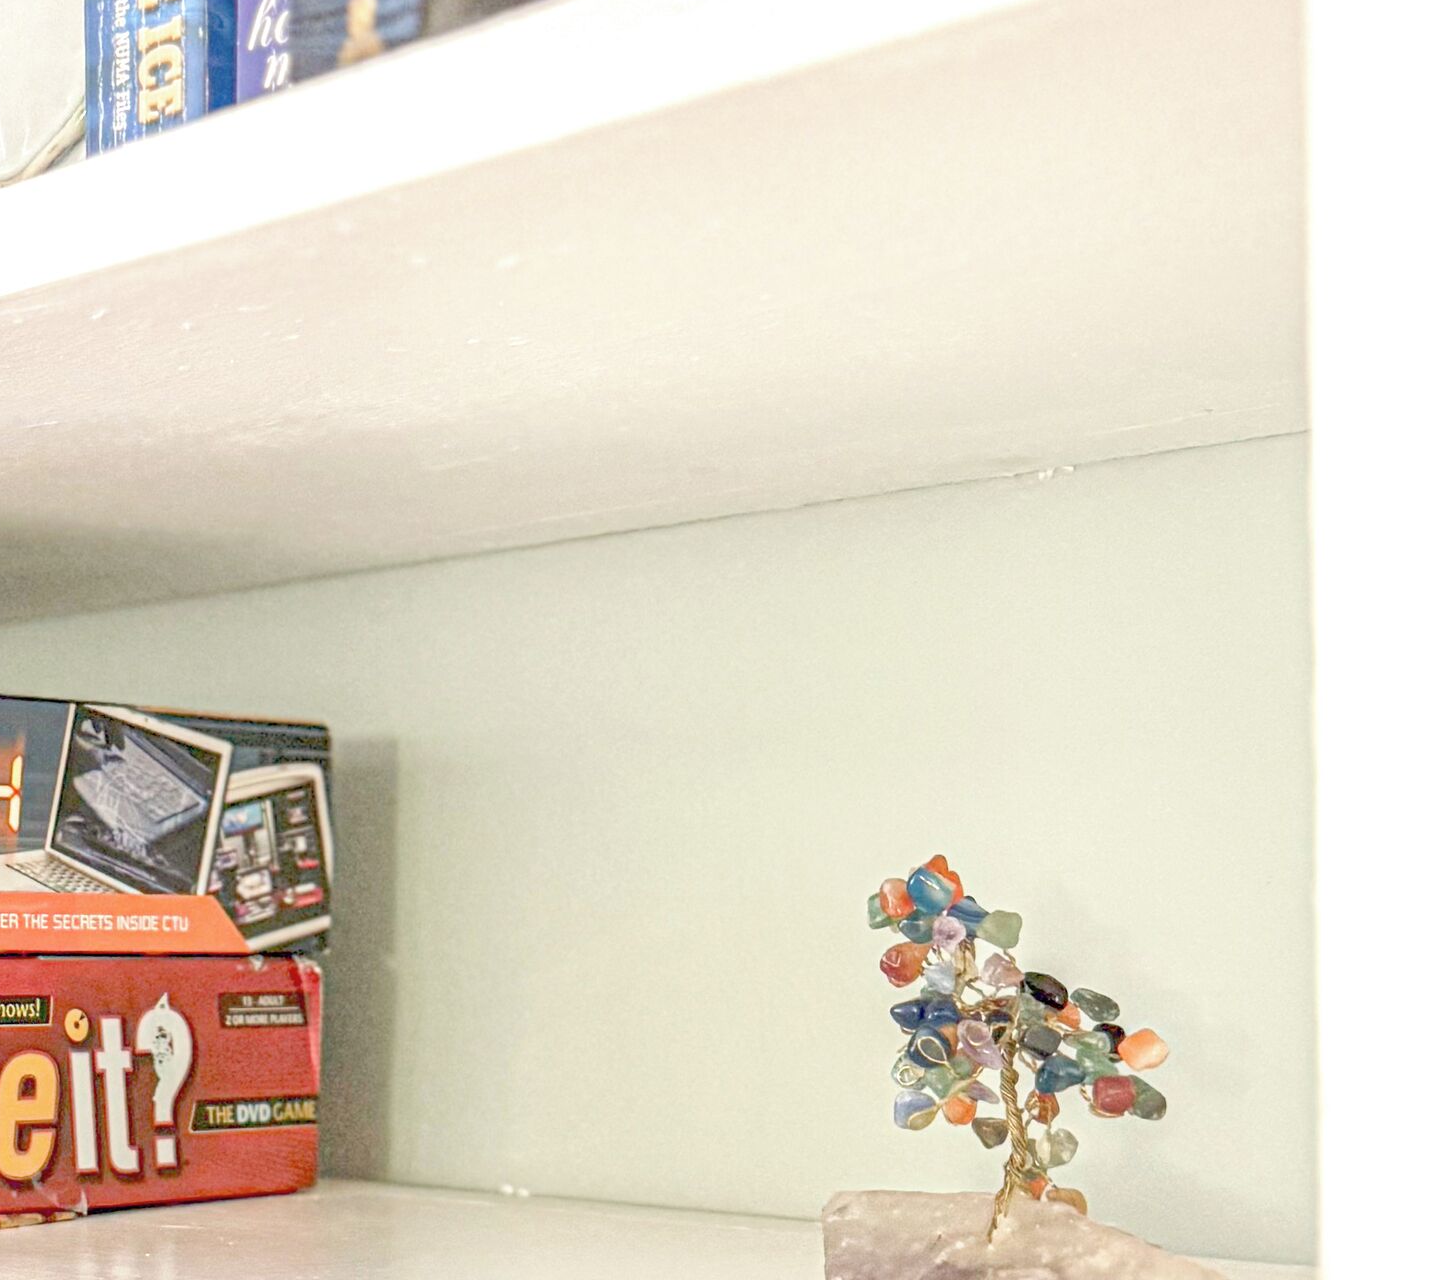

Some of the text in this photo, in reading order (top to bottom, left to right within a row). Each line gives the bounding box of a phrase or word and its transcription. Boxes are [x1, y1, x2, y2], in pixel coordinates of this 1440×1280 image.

[136, 12, 186, 125] ICE
[23, 913, 48, 929] THE
[52, 914, 113, 931] SECRETS
[116, 914, 160, 932] INSIDE
[162, 915, 189, 932] CTU
[206, 1106, 235, 1123] THE
[237, 1102, 271, 1123] DVD
